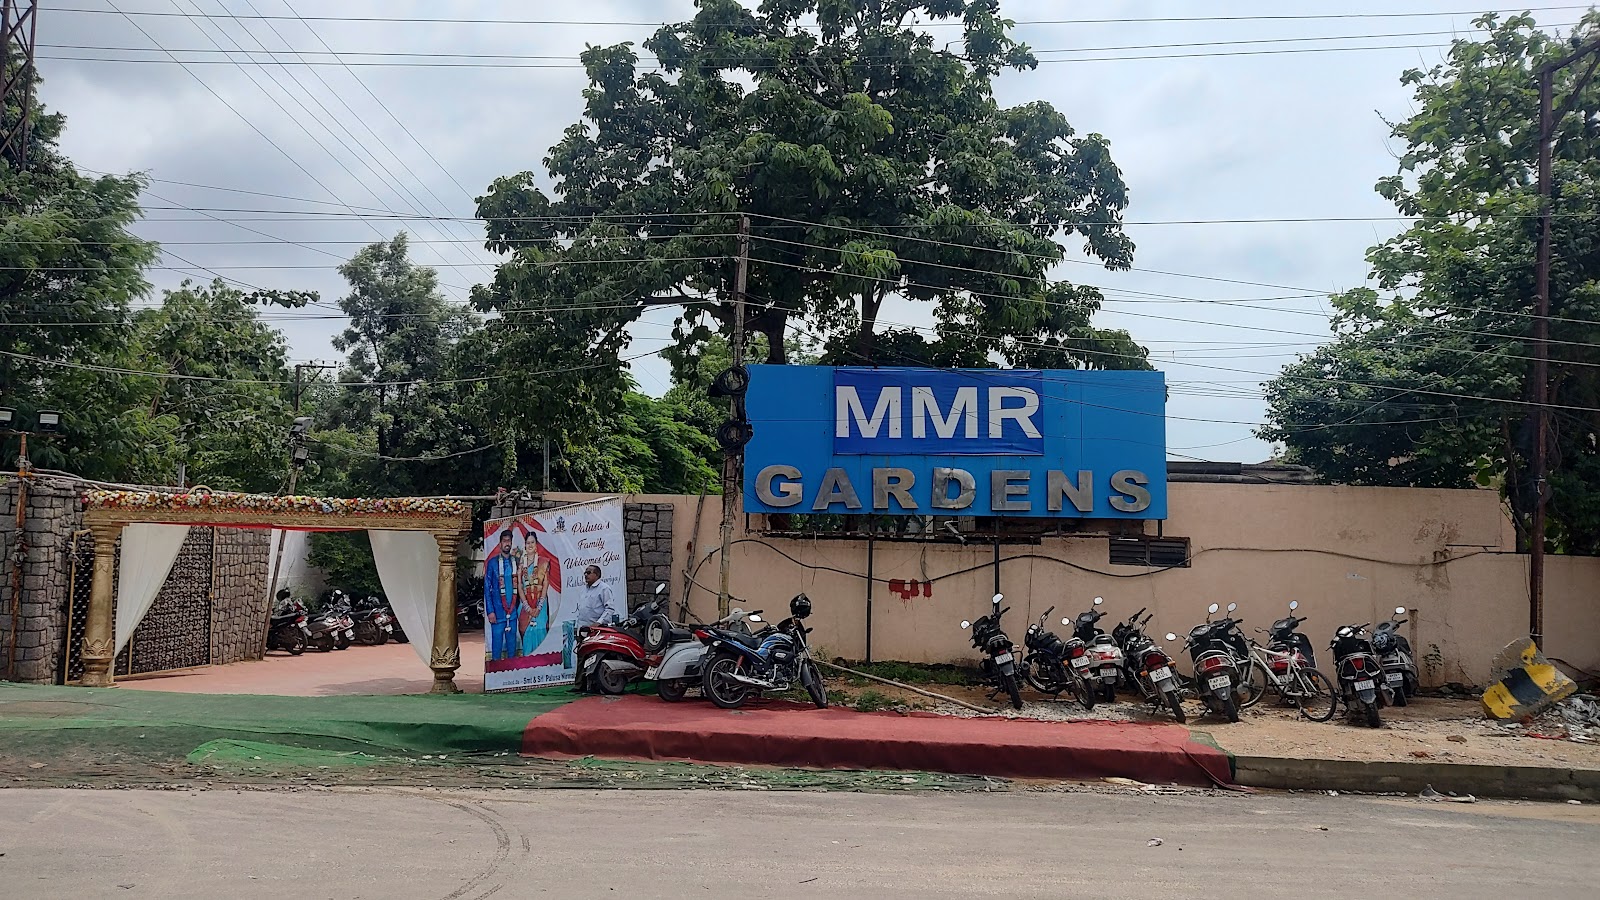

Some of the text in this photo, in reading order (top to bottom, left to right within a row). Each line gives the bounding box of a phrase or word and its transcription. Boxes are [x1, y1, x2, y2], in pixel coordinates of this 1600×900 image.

[835, 385, 1043, 439] MMR
[754, 464, 1152, 513] GARDENS
[571, 521, 610, 535] Palusa's
[577, 537, 605, 550] Family
[563, 551, 621, 570] Welcomes You
[545, 674, 561, 682] Palusa
